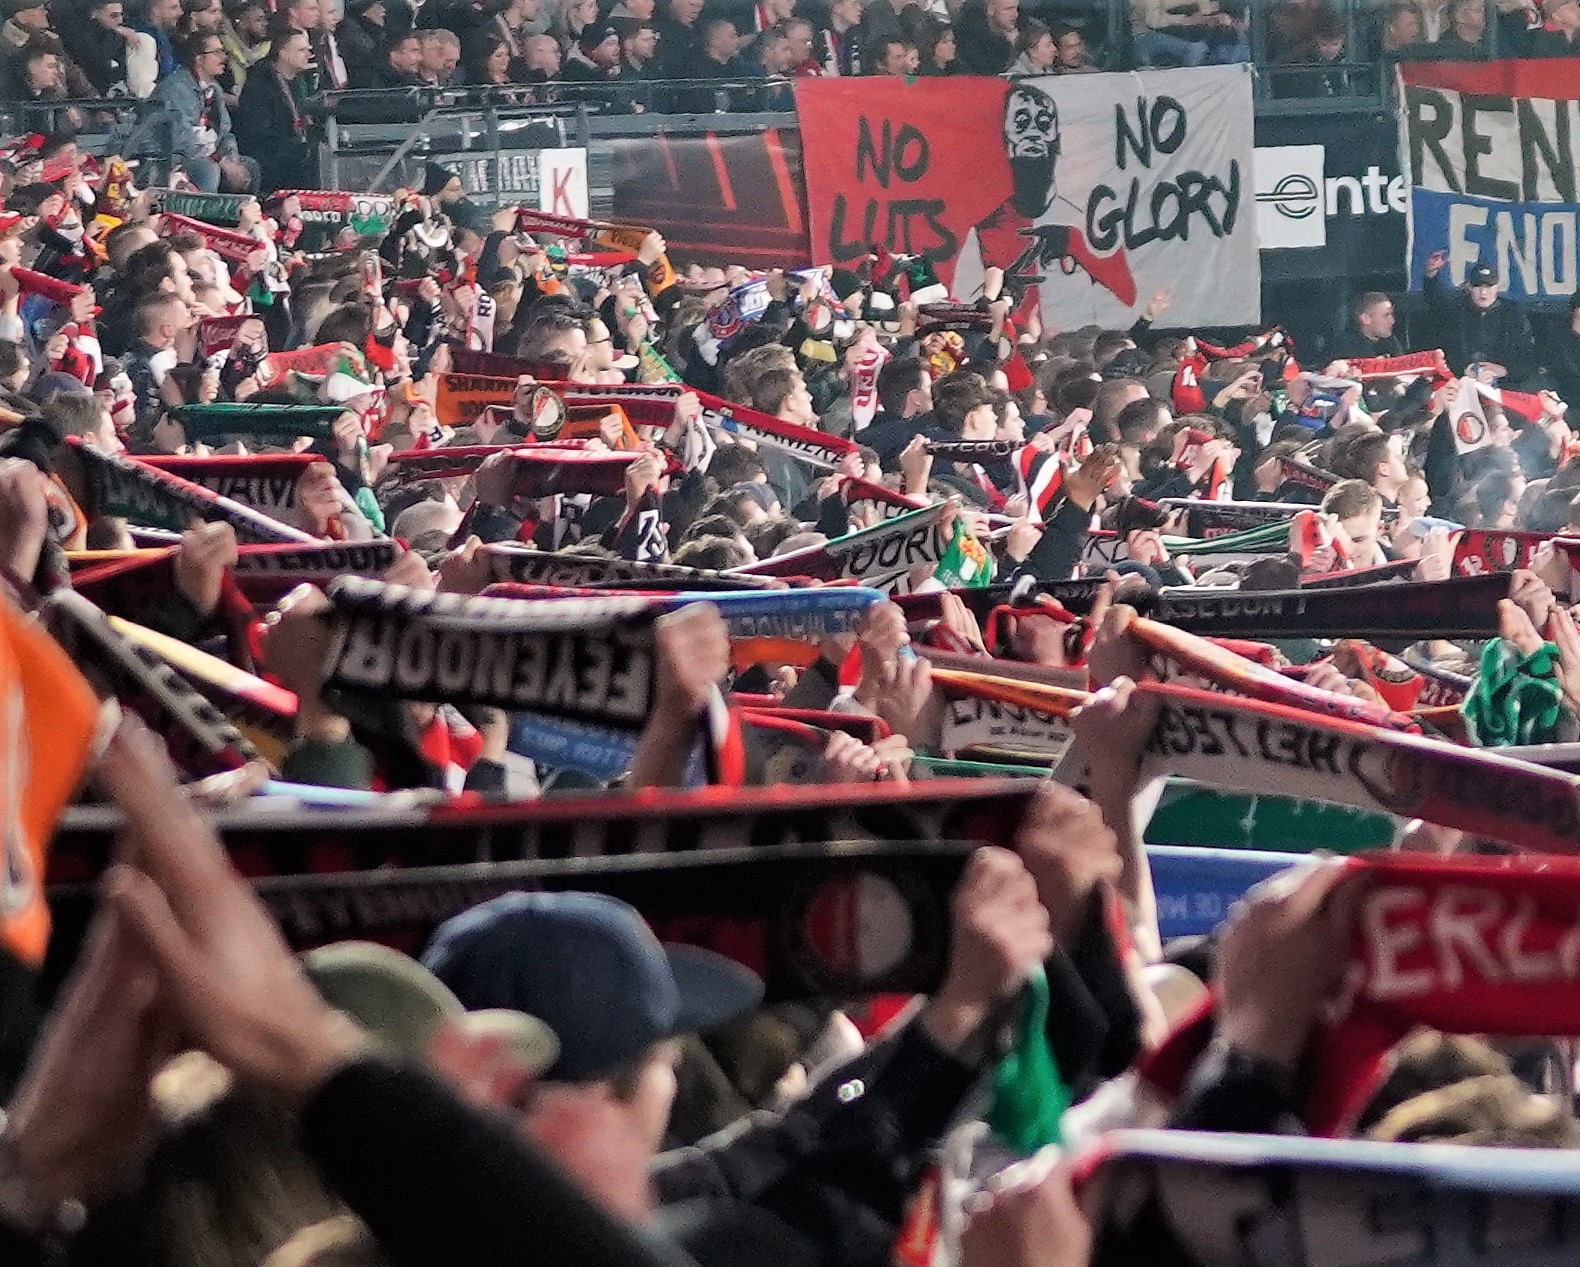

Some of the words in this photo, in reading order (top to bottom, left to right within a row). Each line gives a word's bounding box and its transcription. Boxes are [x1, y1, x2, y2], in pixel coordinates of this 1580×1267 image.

[856, 116, 930, 189] NO
[1116, 95, 1187, 170] NO
[1086, 158, 1241, 251] GLORY
[322, 621, 651, 717] FEYENOOR
